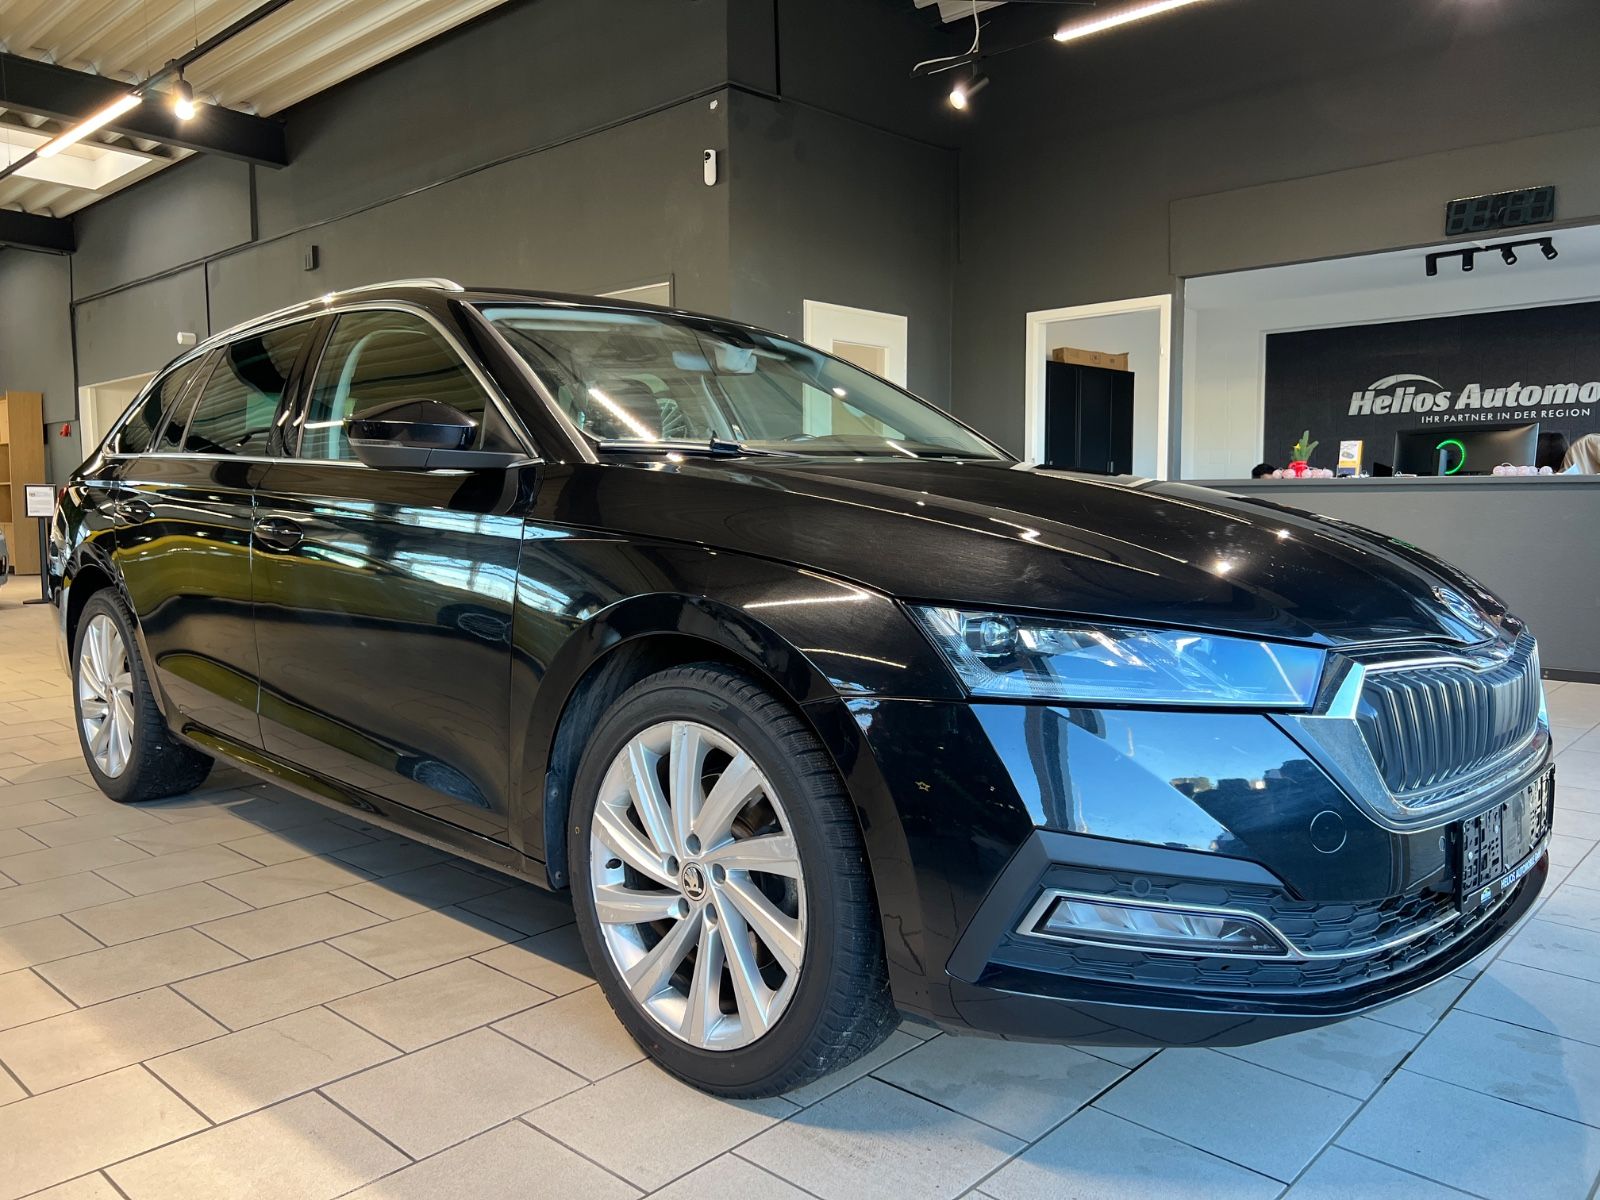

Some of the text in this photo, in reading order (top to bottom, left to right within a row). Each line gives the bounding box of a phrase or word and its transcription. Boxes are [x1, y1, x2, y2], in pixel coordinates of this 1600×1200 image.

[1348, 381, 1600, 416] Helios Automo
[1421, 408, 1591, 424] IHR PARTNER IN DER REGION
